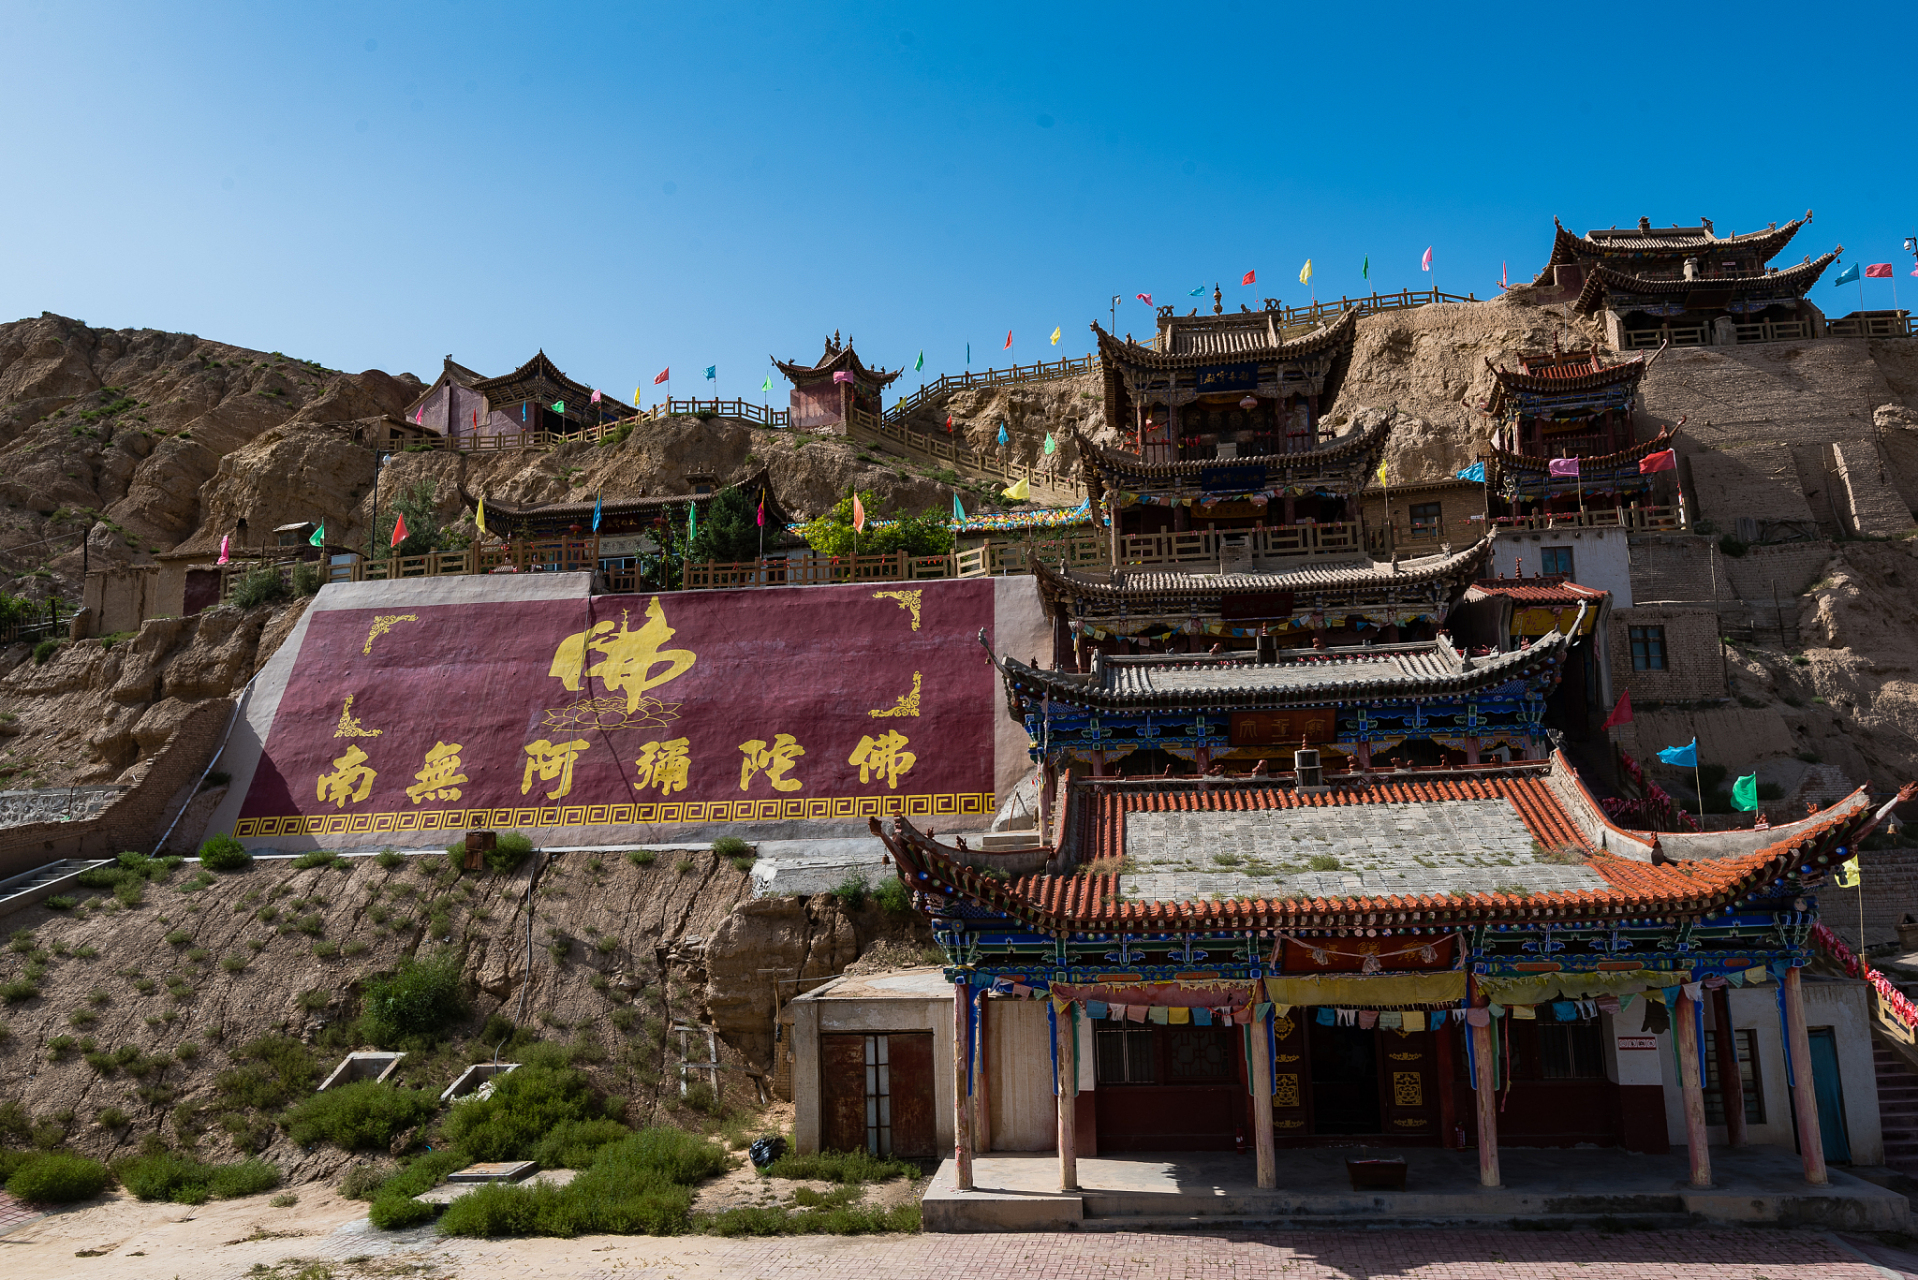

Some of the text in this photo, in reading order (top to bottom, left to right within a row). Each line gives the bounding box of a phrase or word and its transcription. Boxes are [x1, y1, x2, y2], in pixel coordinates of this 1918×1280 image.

[548, 596, 697, 714] 佛
[316, 729, 917, 809] 南無阿彌陀佛
